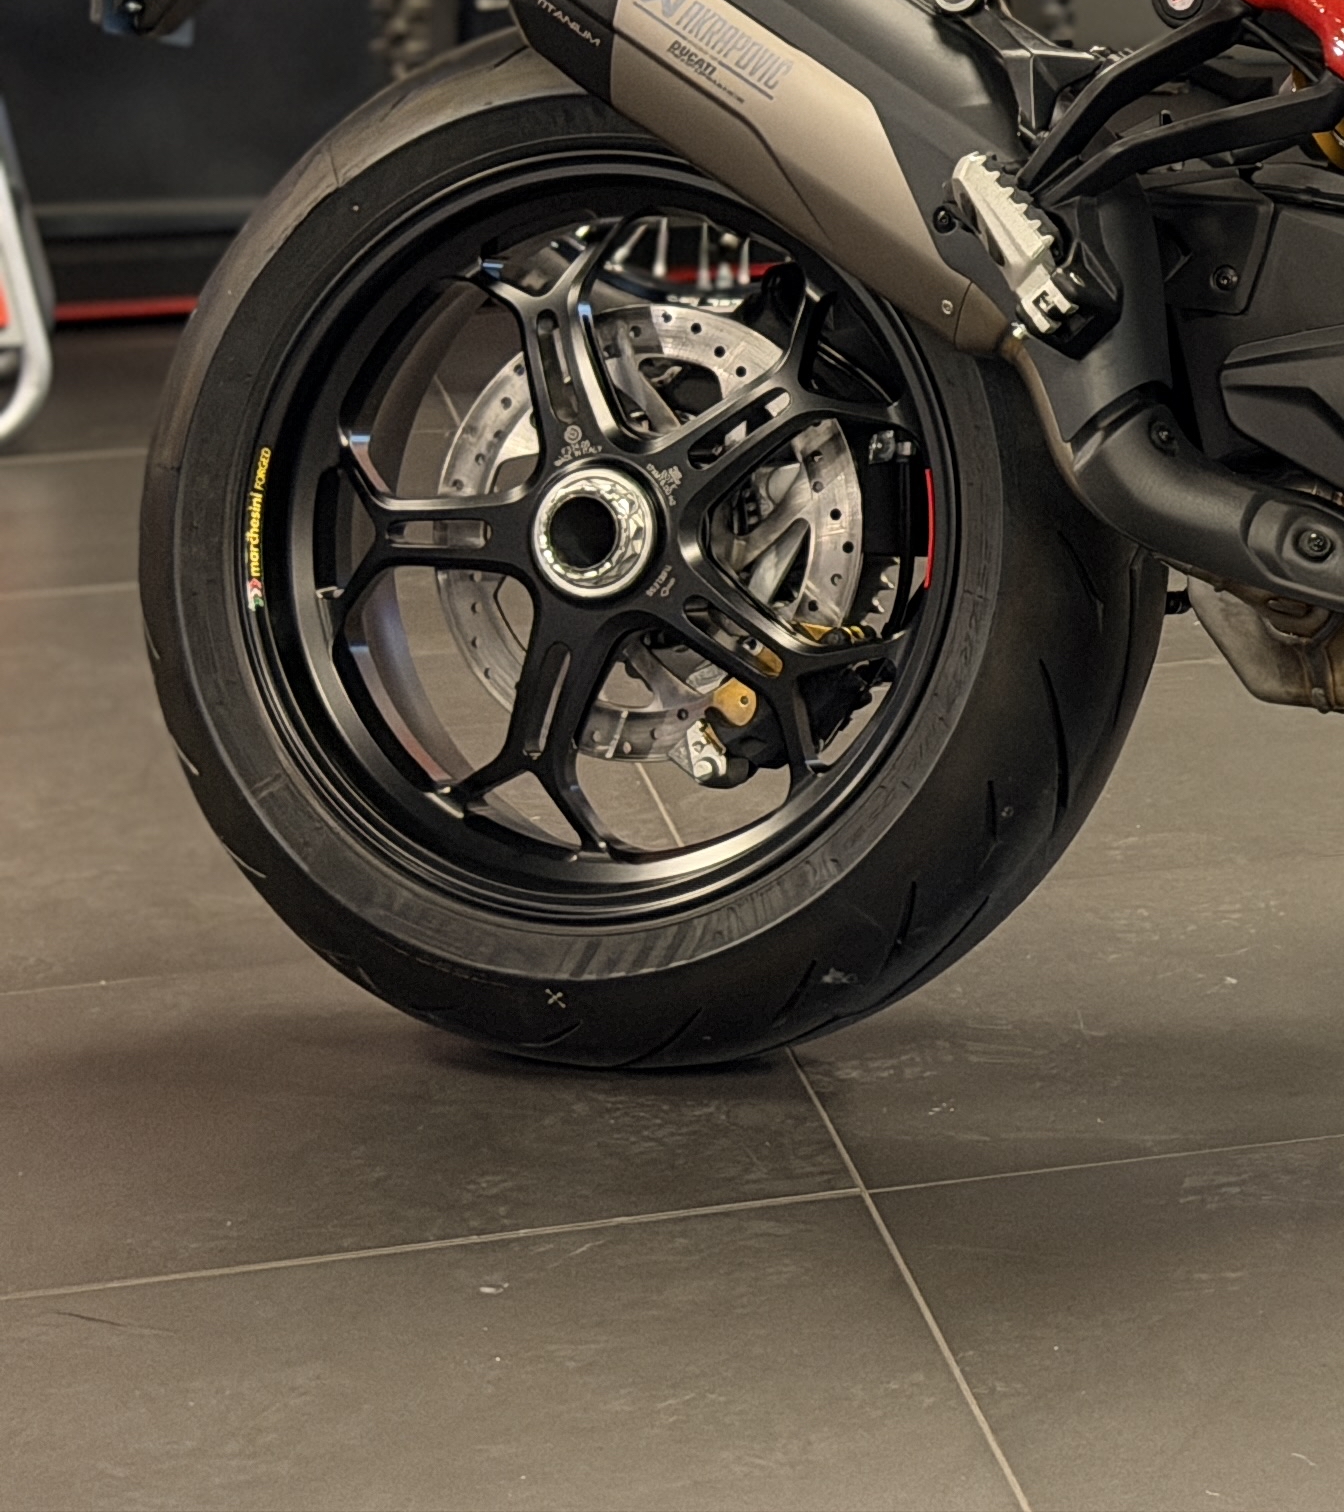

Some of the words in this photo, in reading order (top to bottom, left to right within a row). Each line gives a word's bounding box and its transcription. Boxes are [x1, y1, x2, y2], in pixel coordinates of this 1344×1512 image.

[666, 39, 718, 77] DUCATI
[253, 446, 272, 491] FORGED
[245, 491, 264, 578] marchesini
